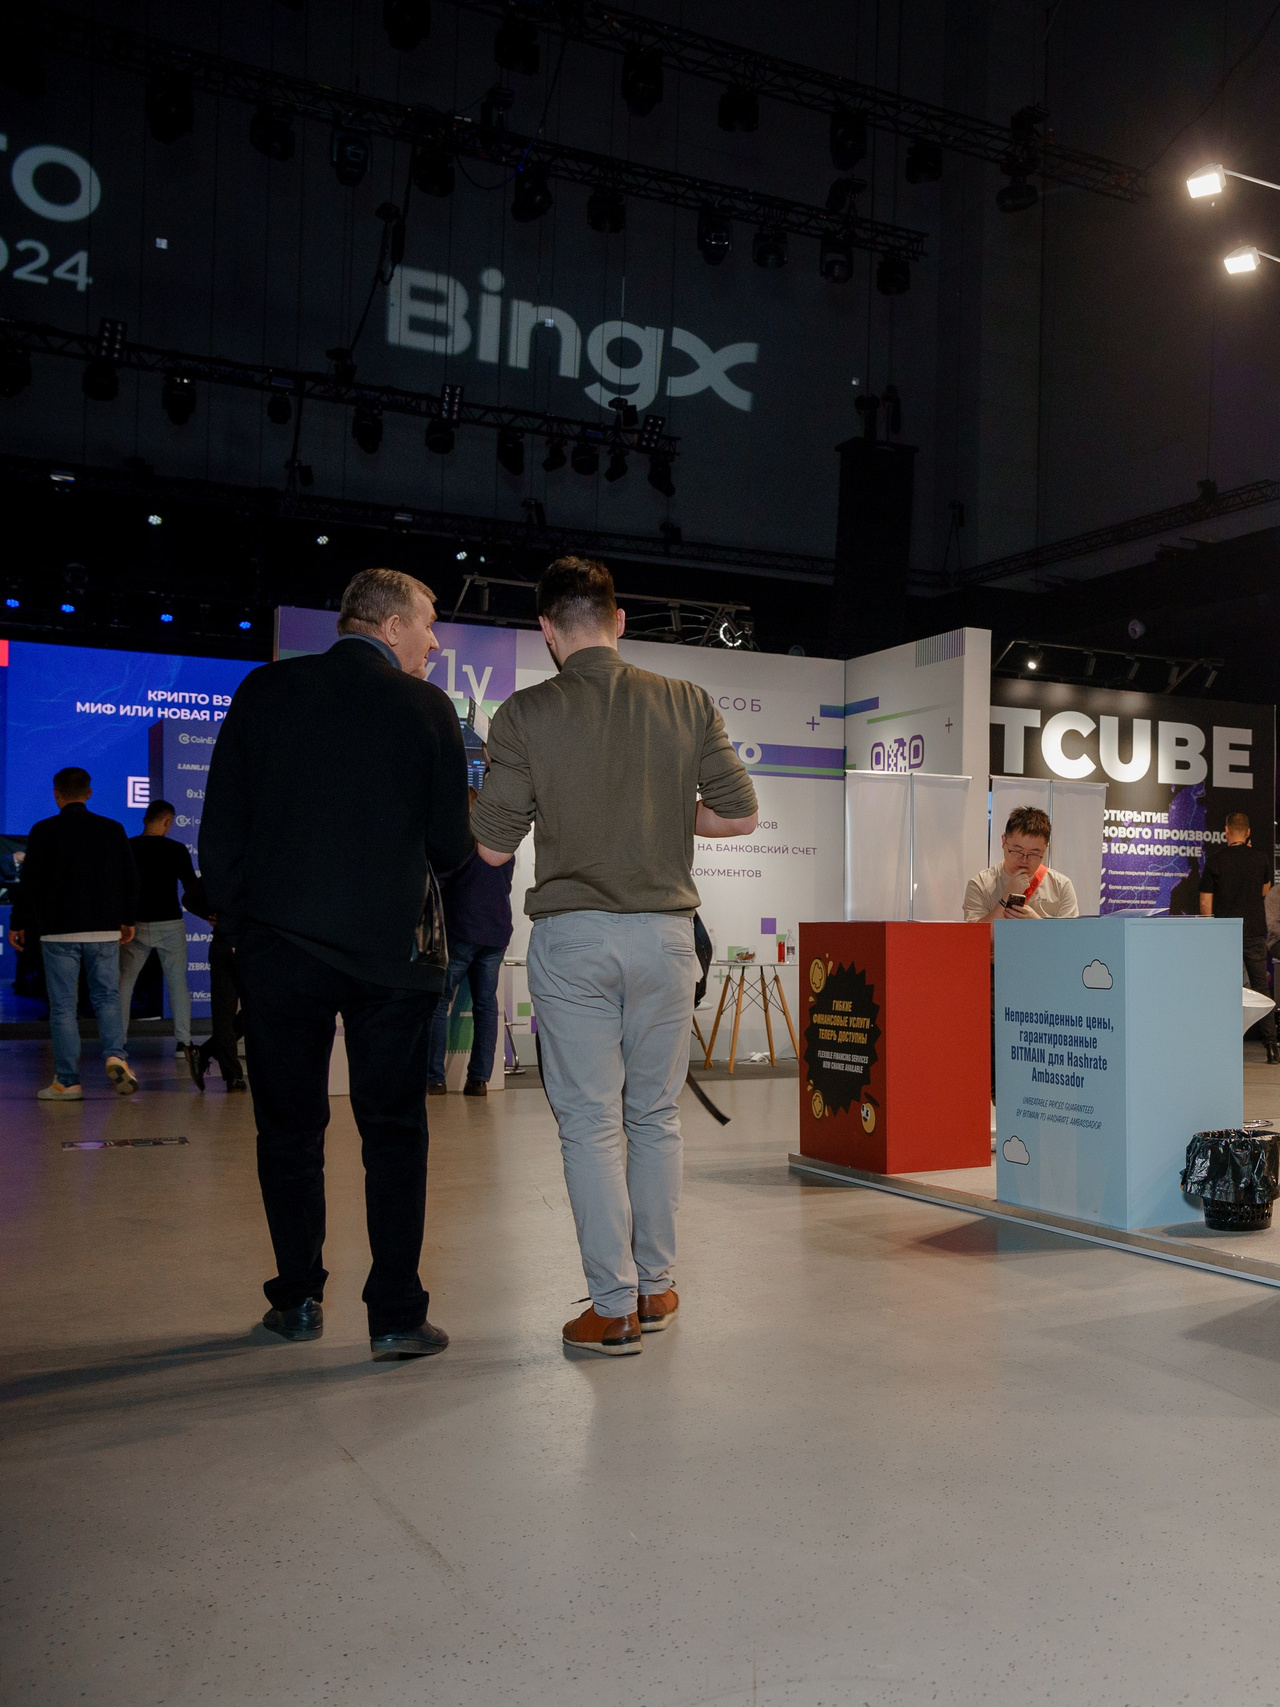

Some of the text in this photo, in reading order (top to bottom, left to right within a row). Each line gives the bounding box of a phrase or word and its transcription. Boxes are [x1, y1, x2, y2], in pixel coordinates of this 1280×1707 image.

[147, 690, 209, 706] КРИПТО
[76, 701, 116, 715] МИФ
[119, 704, 154, 718] ИЛИ
[157, 707, 210, 722] НОВАЯ
[1102, 826, 1152, 840] НОВОГО
[697, 842, 818, 856] НА БАНКОВСКИЙ СЧЕТ
[1111, 843, 1202, 858] КРАСНОЯРСКЕ
[832, 1000, 852, 1012] ГИБКИЕ
[812, 1013, 848, 1027] ФИНАНСОВЫЕ
[849, 1016, 871, 1030] УСЛУГИ
[1005, 1006, 1114, 1033] Непревзойденные цены,
[818, 1028, 868, 1045] ТЕПЕРЬ ДОСТУПНЫ
[1019, 1030, 1098, 1050] гарантированные
[1011, 1045, 1108, 1071] BITMAIN для Hashrate
[1031, 1067, 1085, 1088] Ambassador
[1022, 1096, 1095, 1115] UNBEATABLE PRICES GUARANTEED
[1016, 1108, 1103, 1130] BY BITMAIN TO HASHRATE AMBASSADOR
